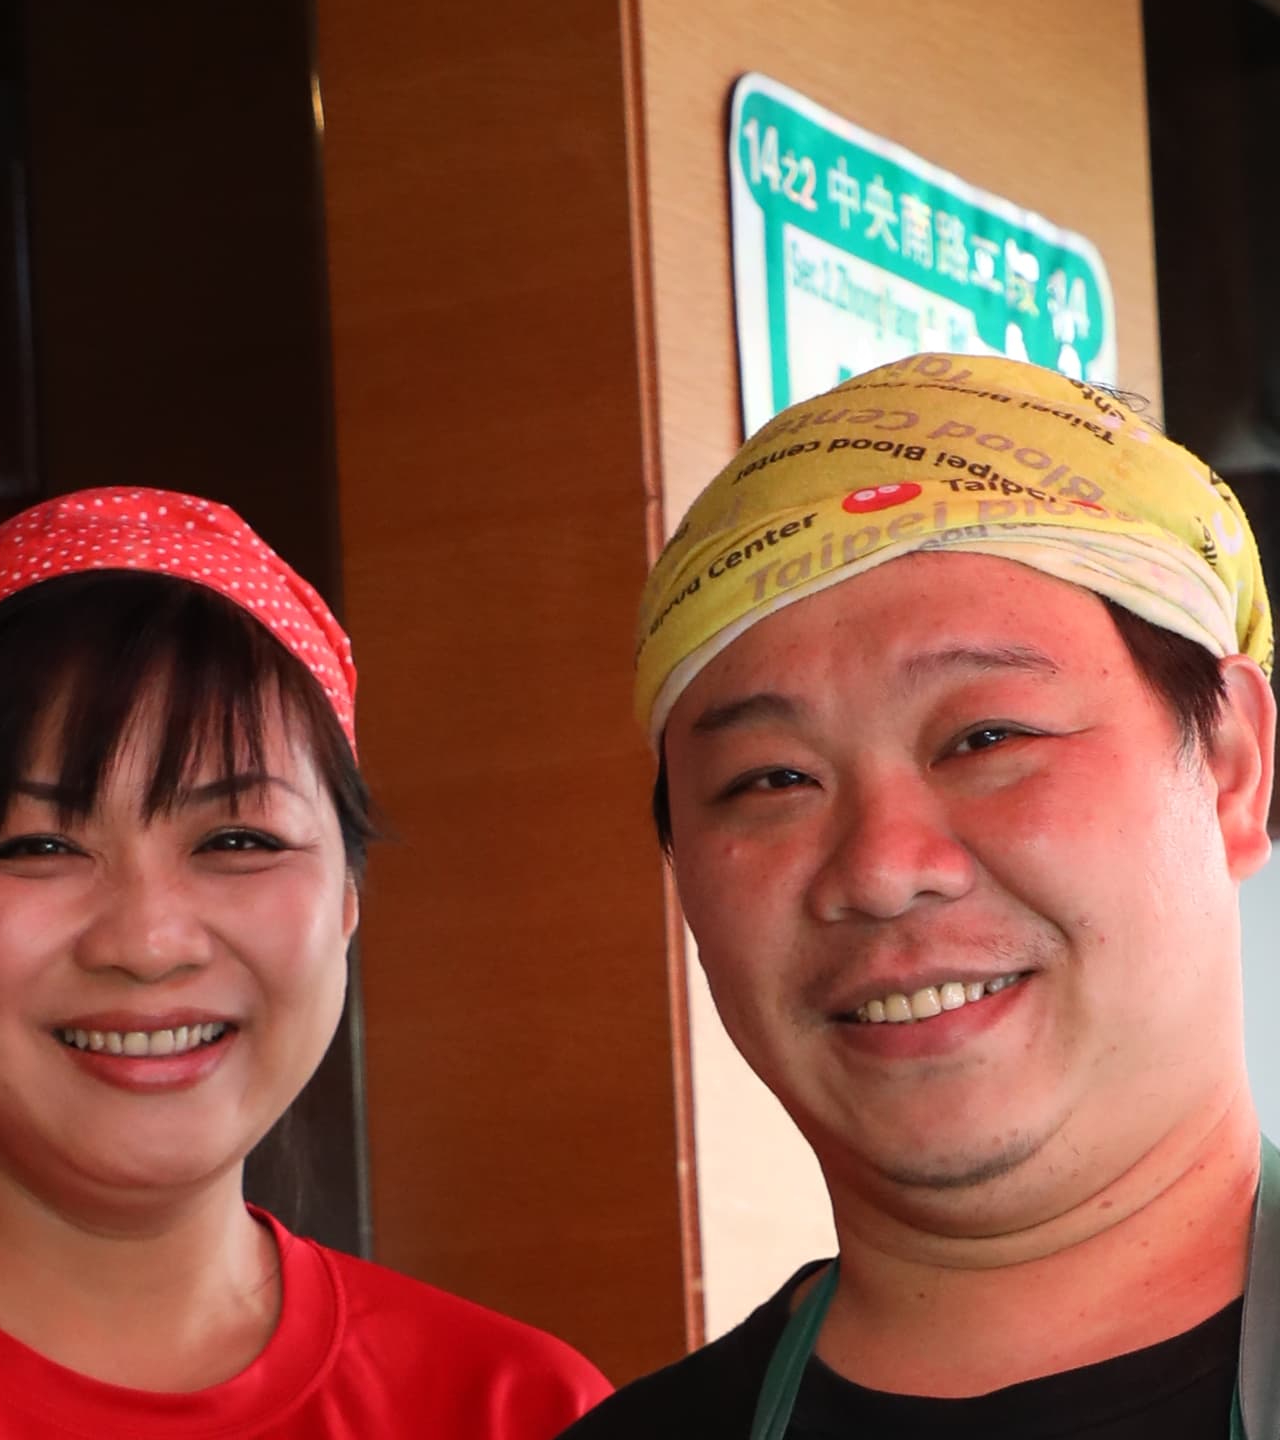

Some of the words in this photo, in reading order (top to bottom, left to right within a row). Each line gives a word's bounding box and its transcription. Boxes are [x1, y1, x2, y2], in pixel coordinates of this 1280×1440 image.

[827, 437, 926, 462] Blood
[927, 420, 1105, 503] Blood
[745, 501, 947, 603] Taipei
